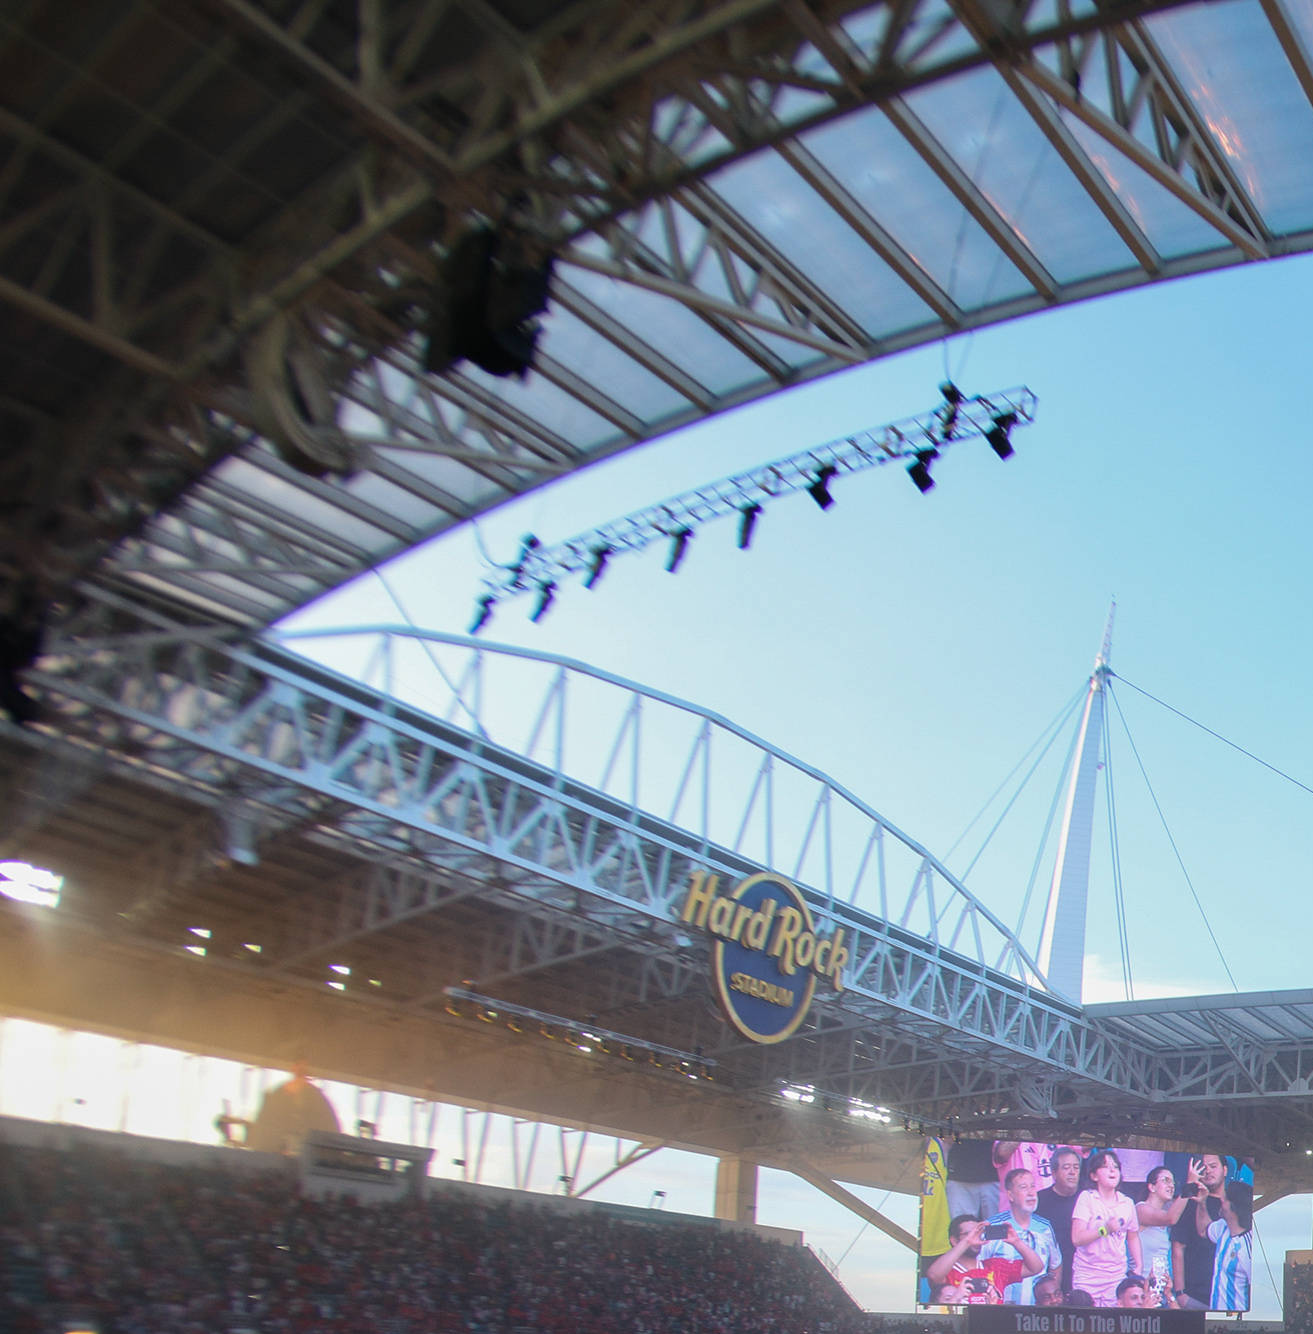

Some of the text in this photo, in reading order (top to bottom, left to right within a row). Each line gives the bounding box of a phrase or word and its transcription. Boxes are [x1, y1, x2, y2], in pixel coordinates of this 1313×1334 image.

[682, 869, 849, 992] Hard Rock
[729, 971, 795, 1008] STADIUM
[1016, 1313, 1161, 1334] Take It To The World
